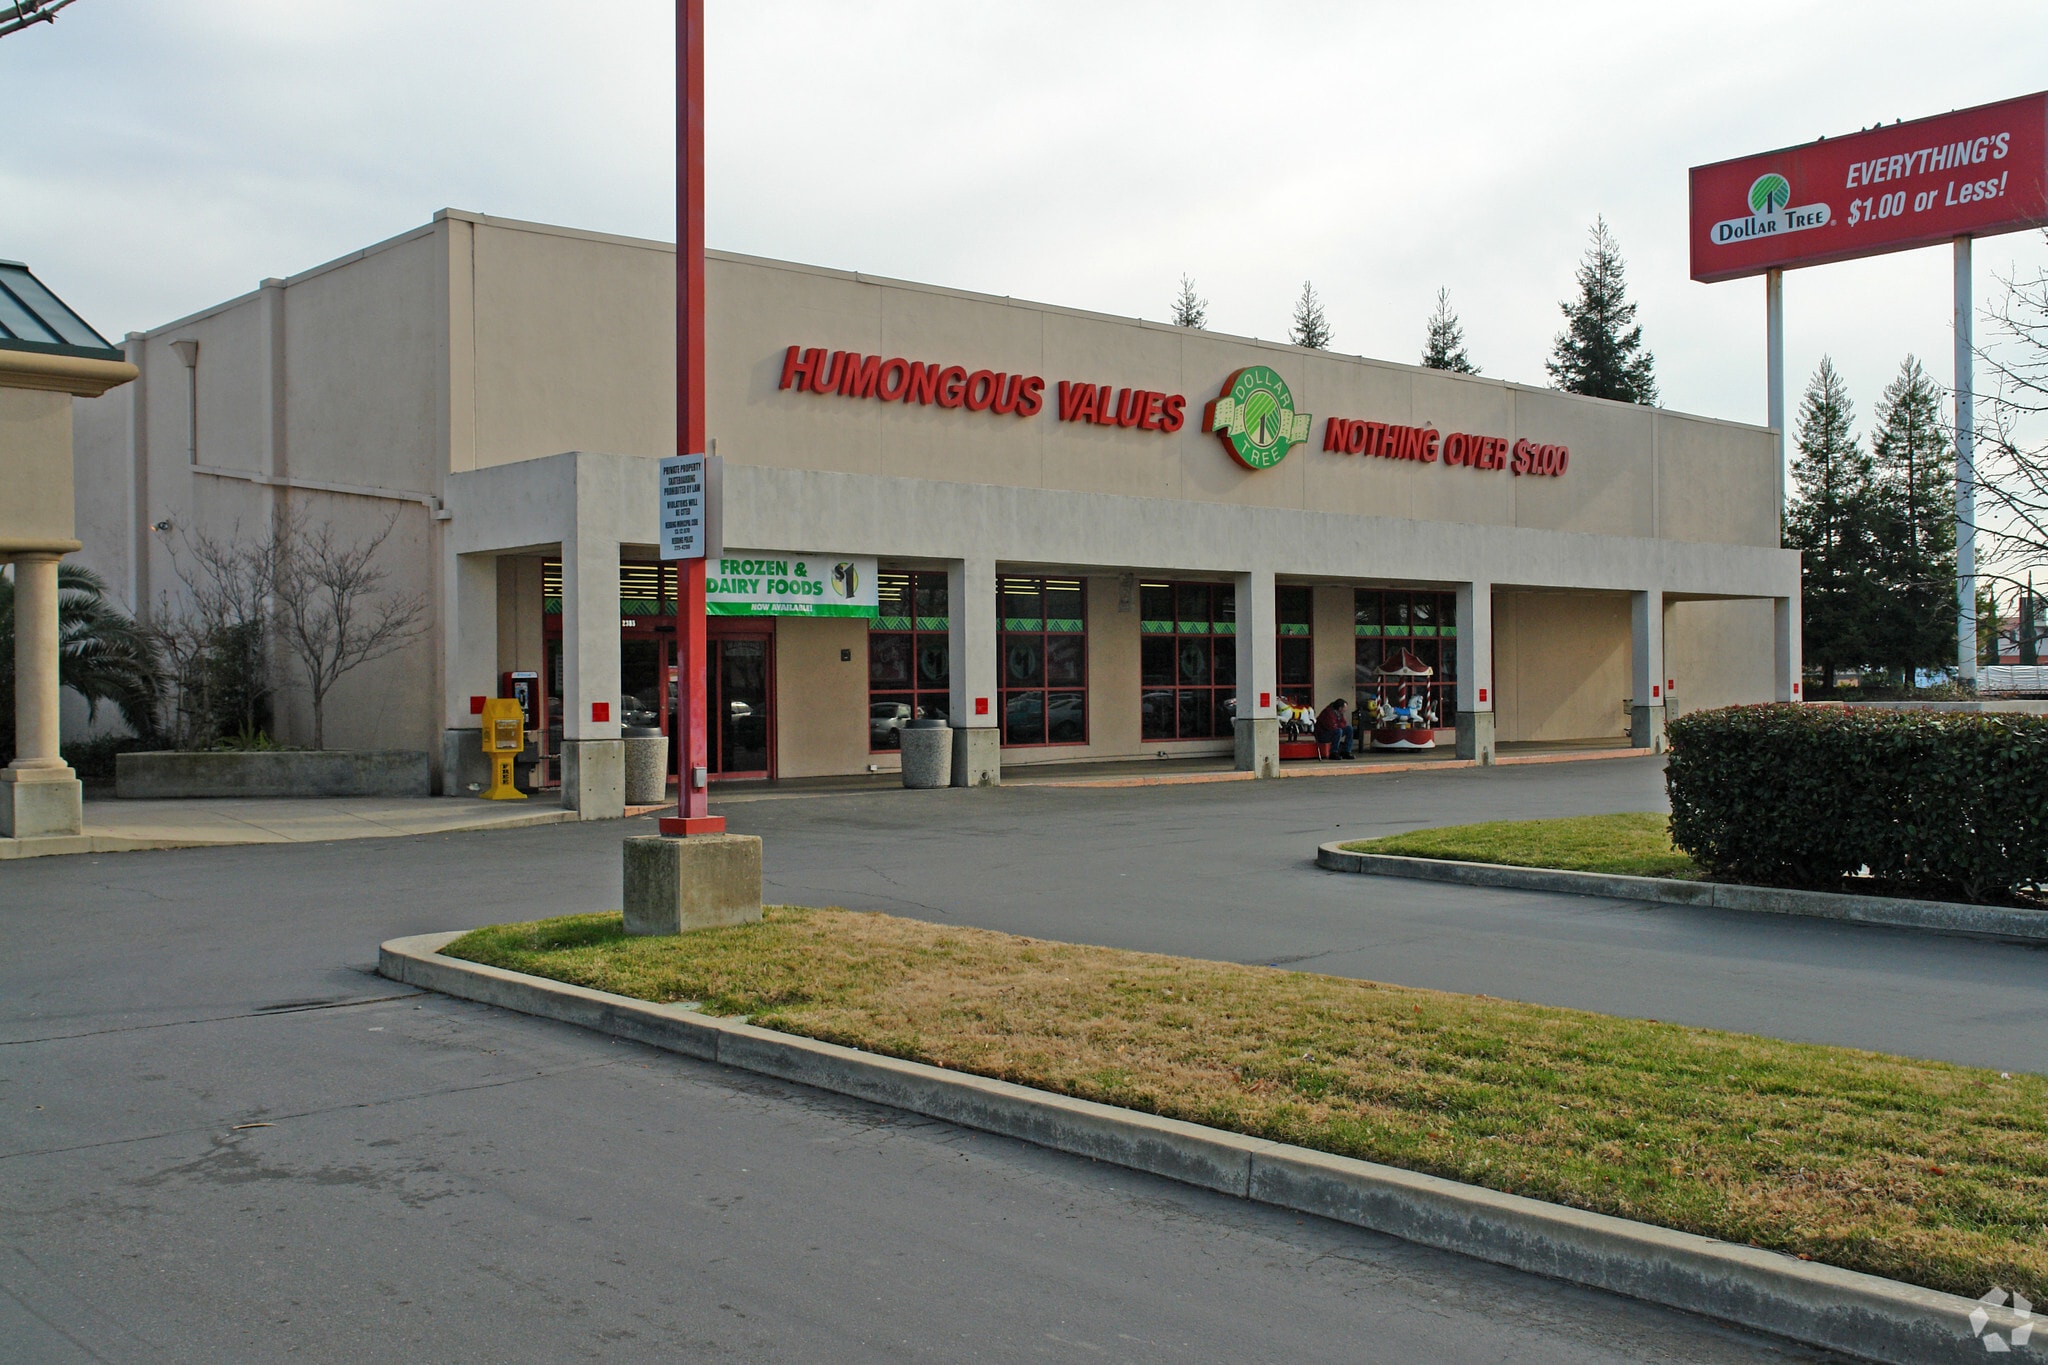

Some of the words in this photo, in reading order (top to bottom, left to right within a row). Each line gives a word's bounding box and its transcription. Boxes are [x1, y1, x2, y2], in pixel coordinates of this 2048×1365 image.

[1846, 132, 2010, 189] EVERYTHING'S
[1847, 191, 1906, 227] $1.00
[1914, 186, 1939, 212] or
[1945, 171, 2008, 207] Less!
[779, 345, 1045, 417] HUMONGOUS
[1058, 380, 1187, 433] VALUES
[1235, 370, 1291, 407] DOLLAR
[1241, 440, 1281, 466] TREE
[1323, 416, 1440, 462] NOTHING
[1443, 432, 1509, 470] OVER
[1511, 438, 1569, 477] $1.00
[680, 462, 701, 473] PROPERTY
[720, 559, 788, 576] FROZEN
[794, 562, 808, 577] &
[706, 577, 760, 594] DAIRY
[767, 579, 824, 596] FOODS
[751, 603, 770, 611] NOW
[771, 603, 813, 612] AVAILABLE!
